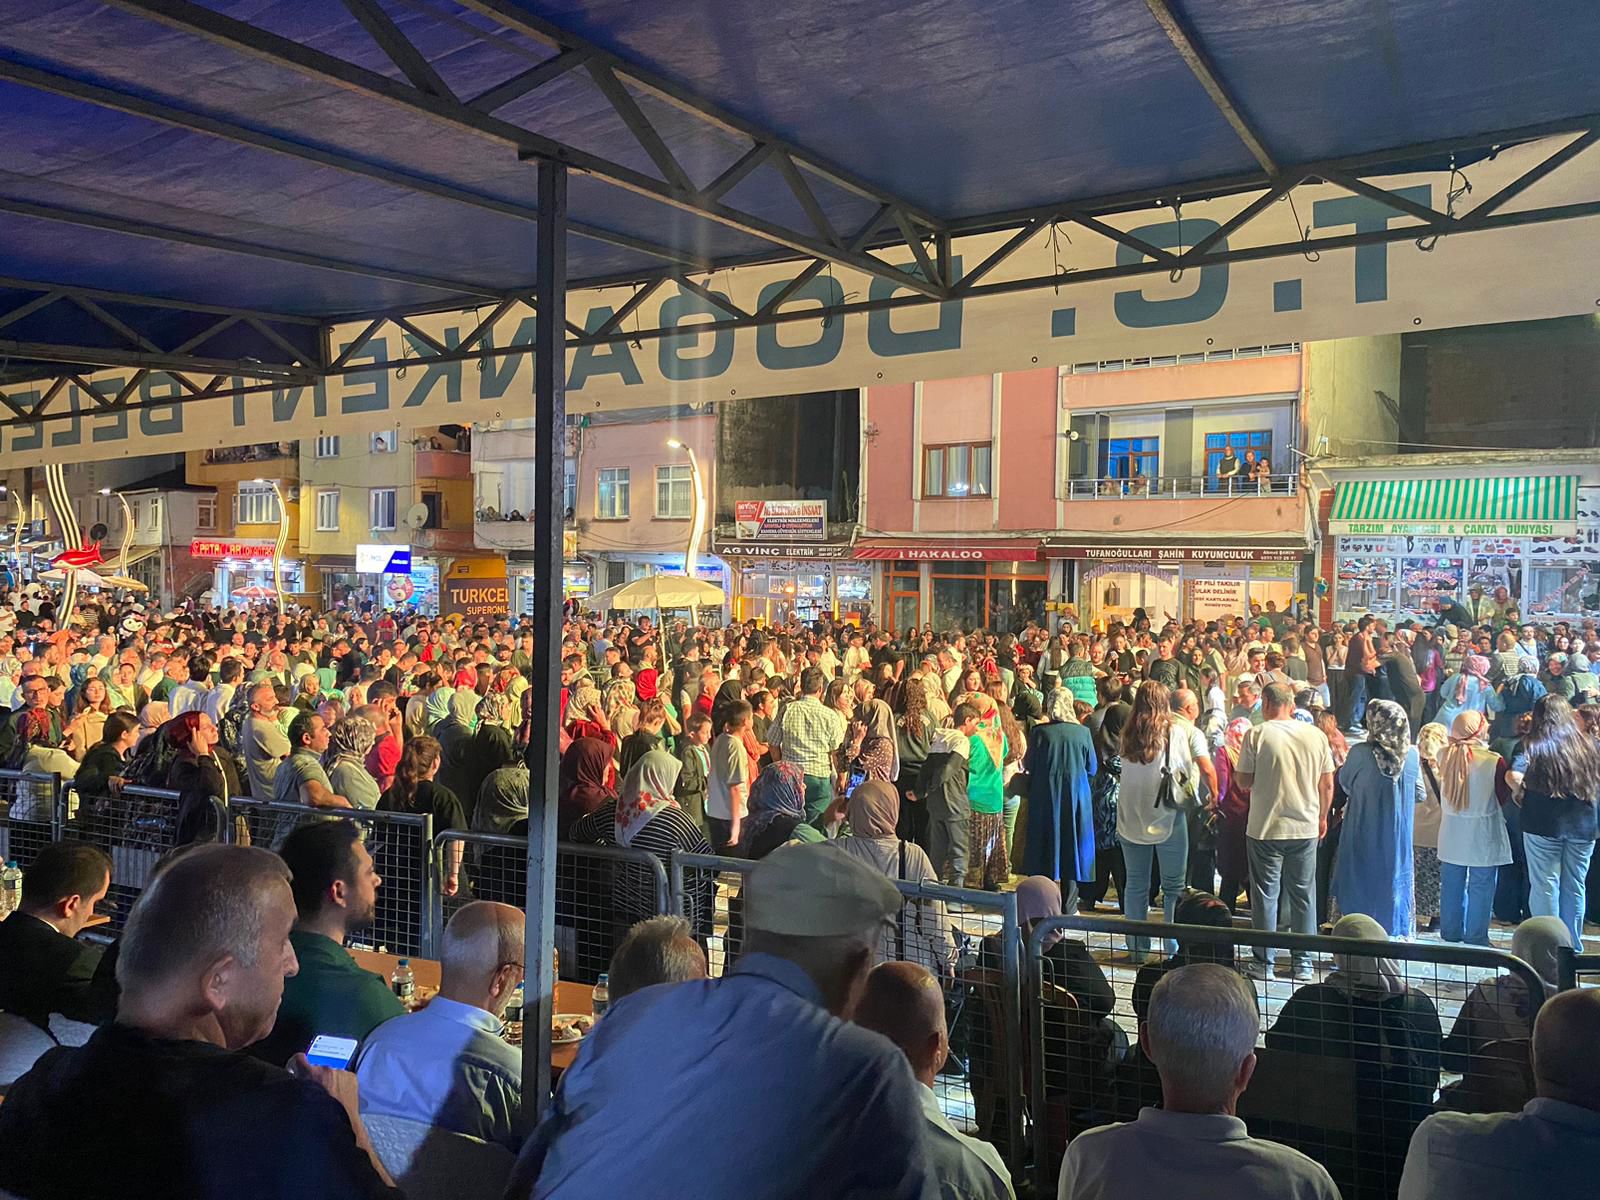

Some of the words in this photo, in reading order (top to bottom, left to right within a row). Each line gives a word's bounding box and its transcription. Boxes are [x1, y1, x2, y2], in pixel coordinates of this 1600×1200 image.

[1348, 524, 1384, 533] TARZIM
[1448, 524, 1455, 533] &
[745, 546, 780, 555] VİNÇ
[786, 546, 814, 556] ELEKTRİK
[908, 551, 983, 559] HAKALOO
[1085, 549, 1152, 558] TUFANOĞULLARI
[1158, 549, 1184, 559] ŞAHİN
[1192, 550, 1254, 559] KUYUMCULUK
[825, 564, 831, 578] AG
